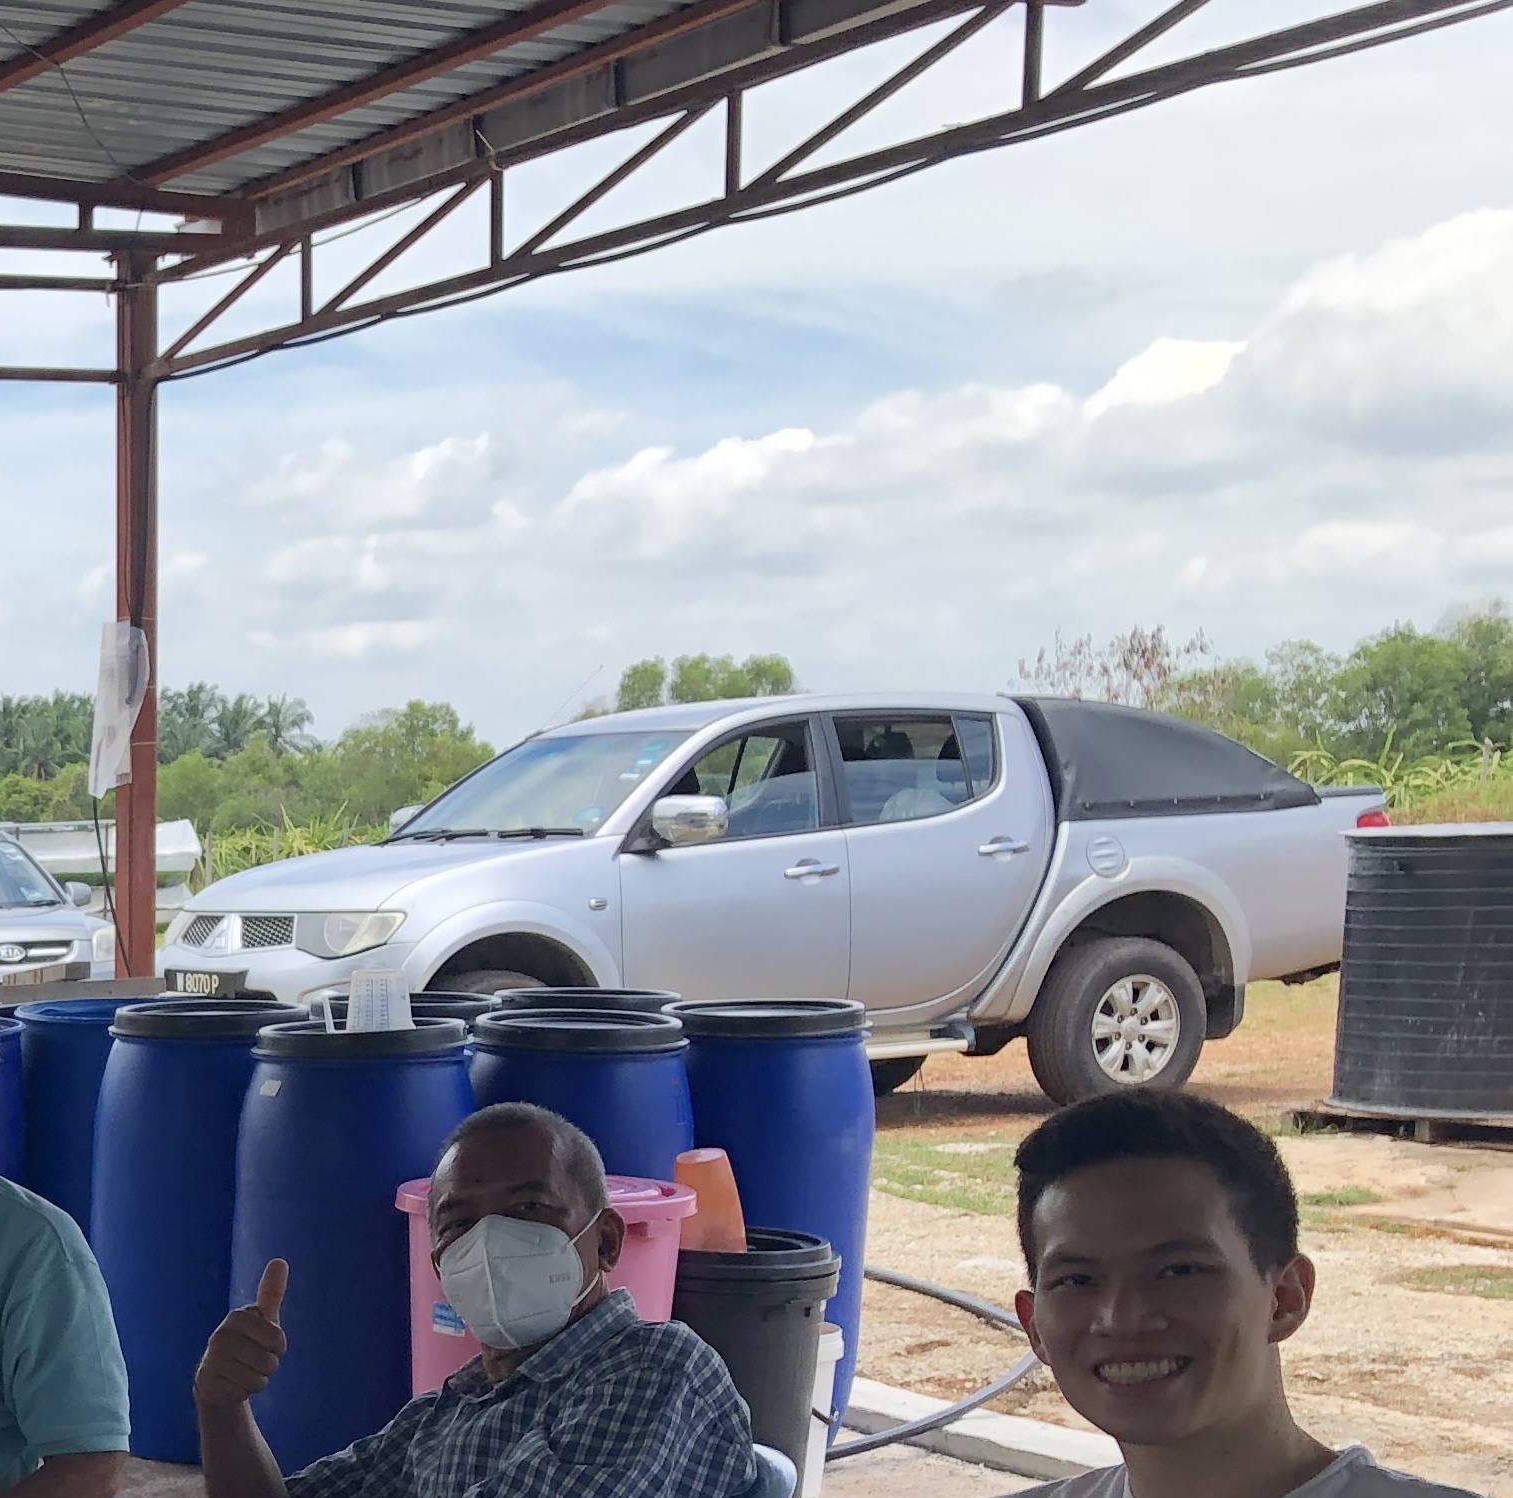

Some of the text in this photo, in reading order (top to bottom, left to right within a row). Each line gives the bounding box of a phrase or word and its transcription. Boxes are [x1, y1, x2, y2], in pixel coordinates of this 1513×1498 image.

[176, 972, 220, 995] W 8070 P
